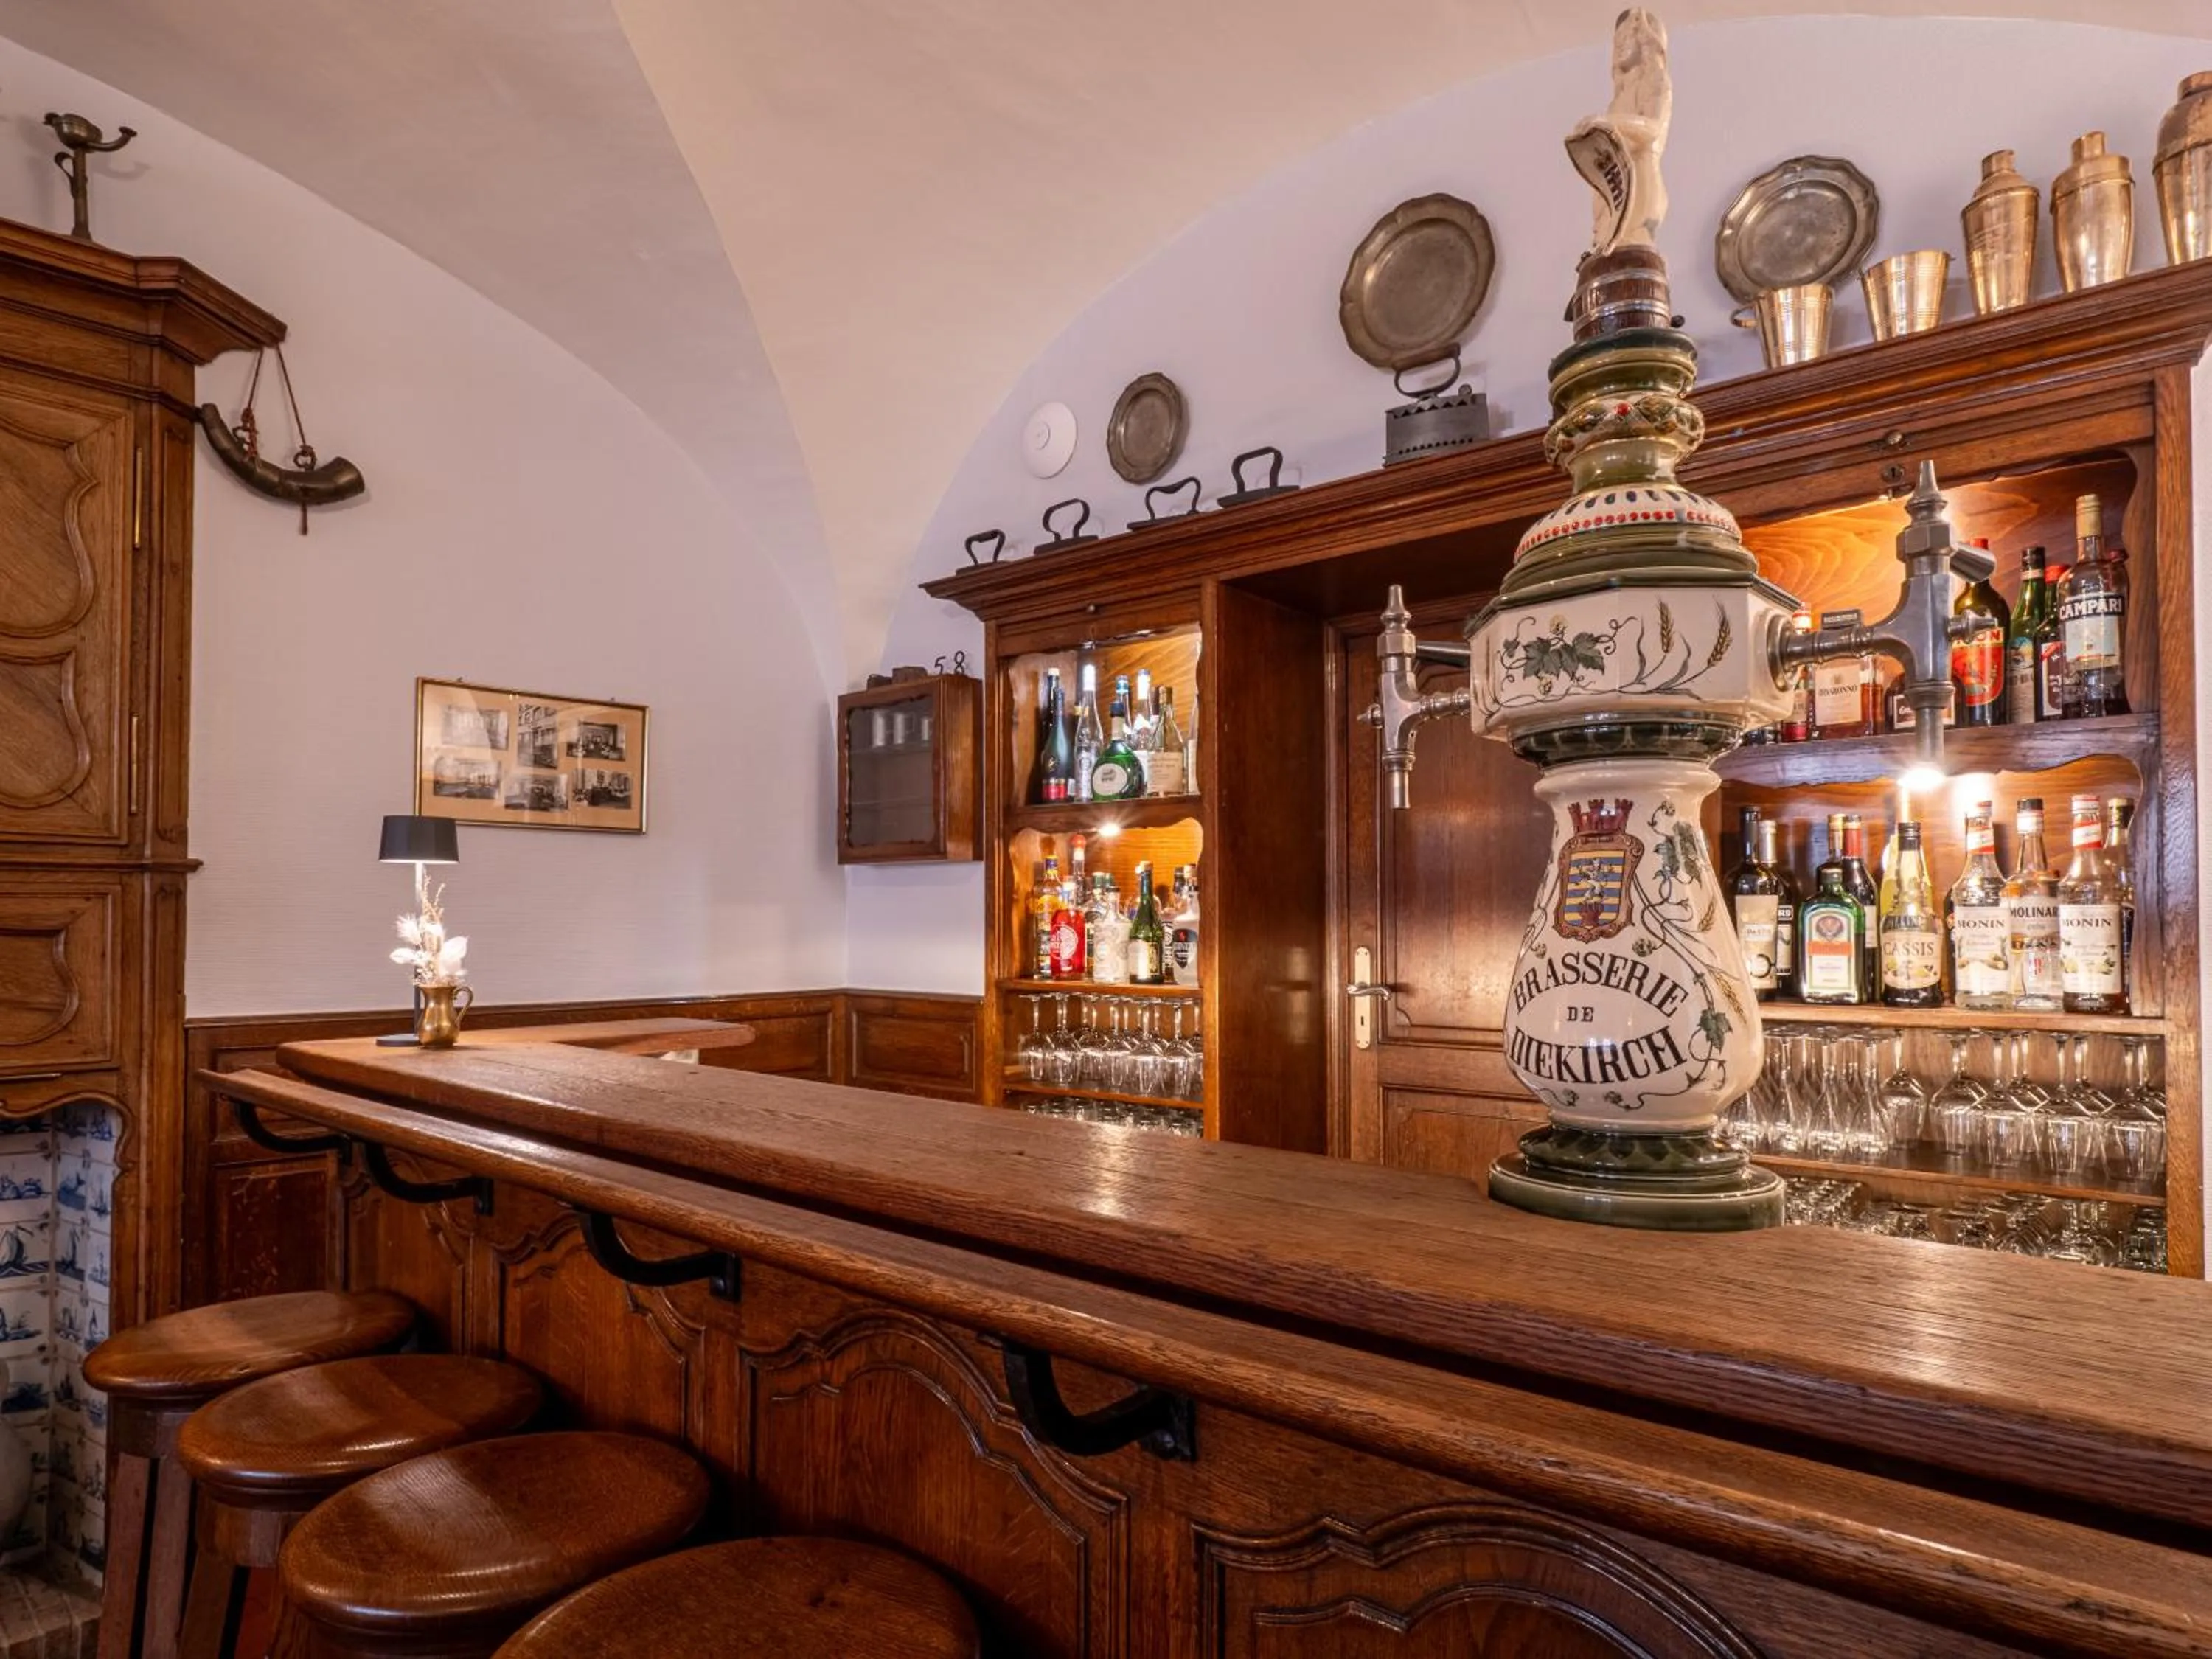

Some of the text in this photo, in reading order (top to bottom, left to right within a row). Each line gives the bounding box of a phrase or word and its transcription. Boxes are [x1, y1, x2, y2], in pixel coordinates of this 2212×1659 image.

[2059, 597, 2122, 620] CAMPARI
[1958, 919, 2006, 928] MONIN
[2062, 918, 2112, 928] MONIN
[1883, 942, 1935, 956] CASSIS
[1514, 951, 1689, 1018] BRASSERIE
[1567, 1006, 1594, 1022] DE
[1509, 1025, 1688, 1084] DIEKIRCH
